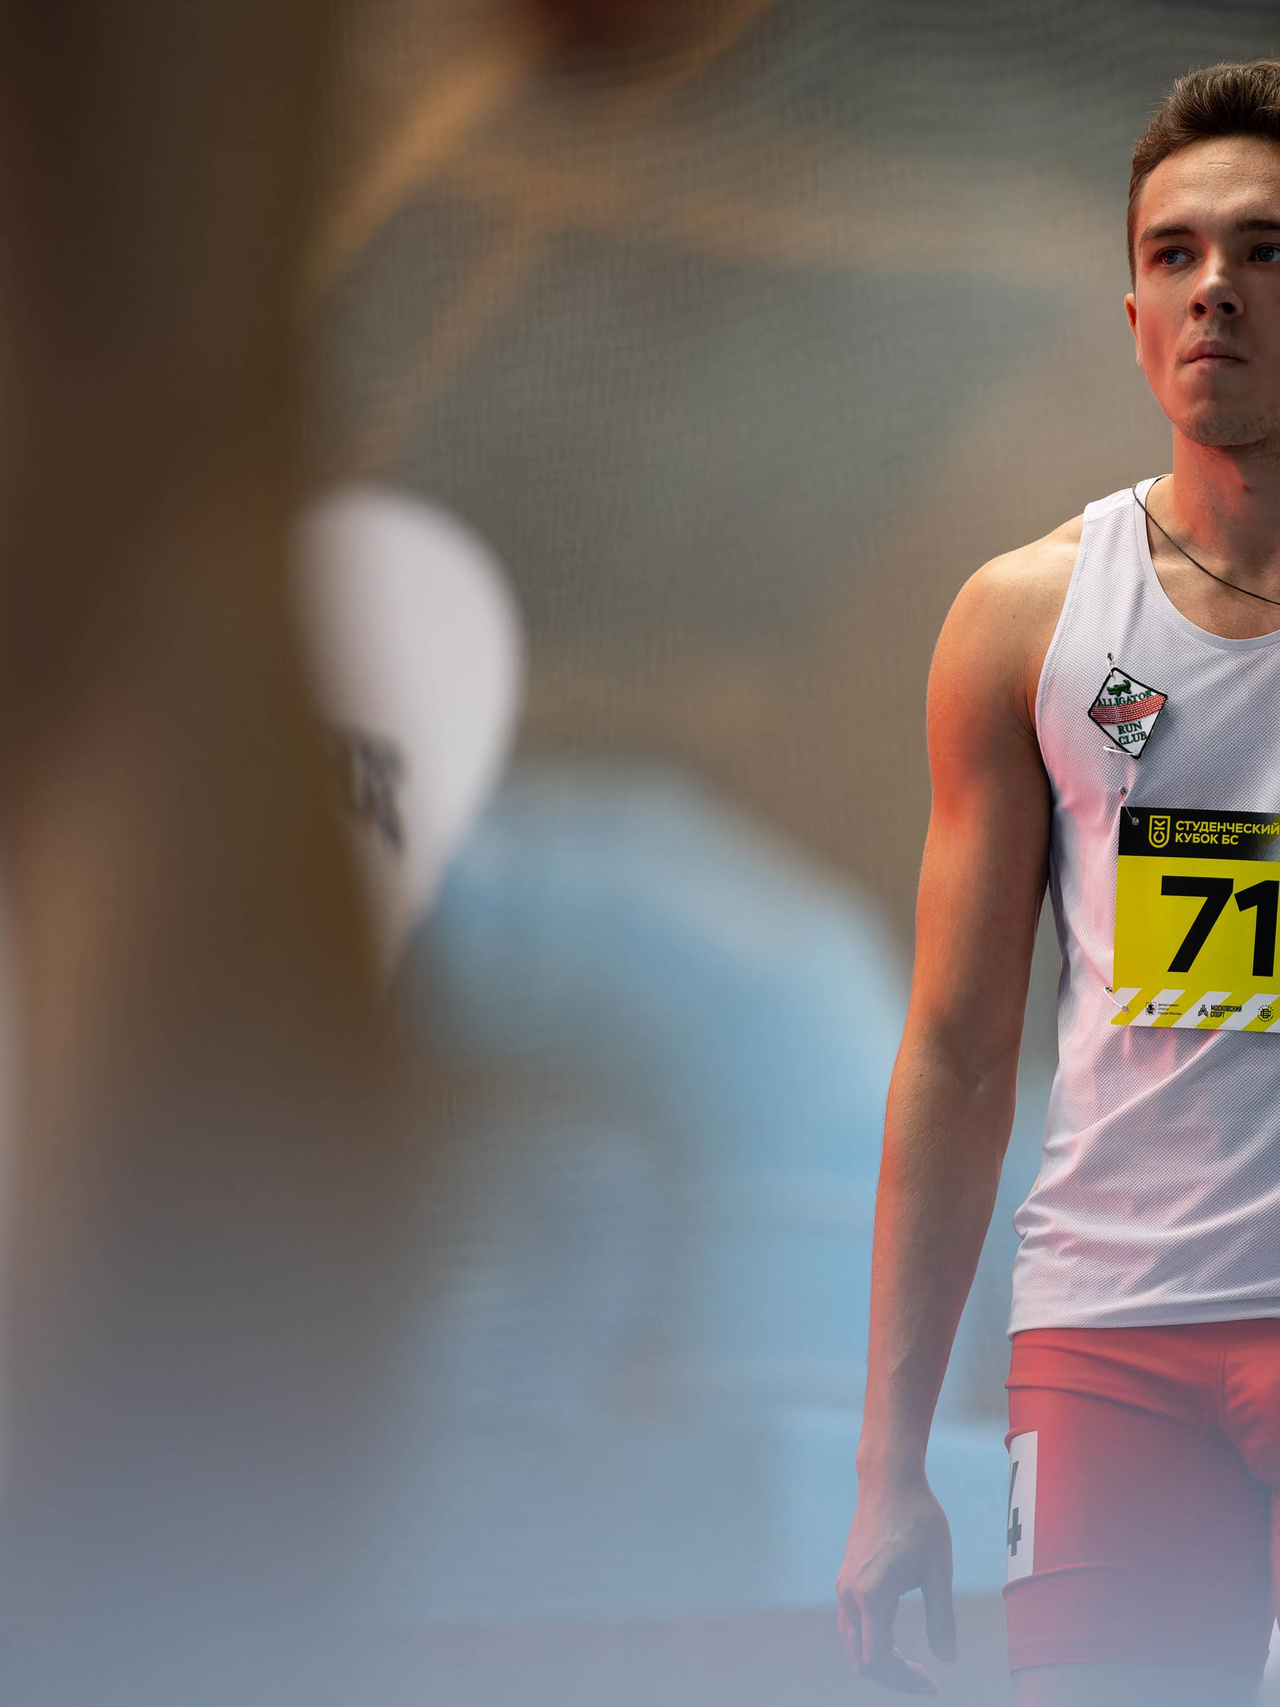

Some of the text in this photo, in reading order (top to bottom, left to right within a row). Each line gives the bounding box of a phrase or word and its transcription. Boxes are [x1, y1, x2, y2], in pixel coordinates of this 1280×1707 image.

[1097, 689, 1153, 707] ALLIGATOR
[1117, 721, 1143, 735] RUN
[1118, 731, 1147, 745] CLUB
[1175, 820, 1280, 836] СТУДЕНЧЕСКИЙ
[1175, 832, 1239, 846] КУБОК БС
[1007, 1460, 1022, 1557] 4
